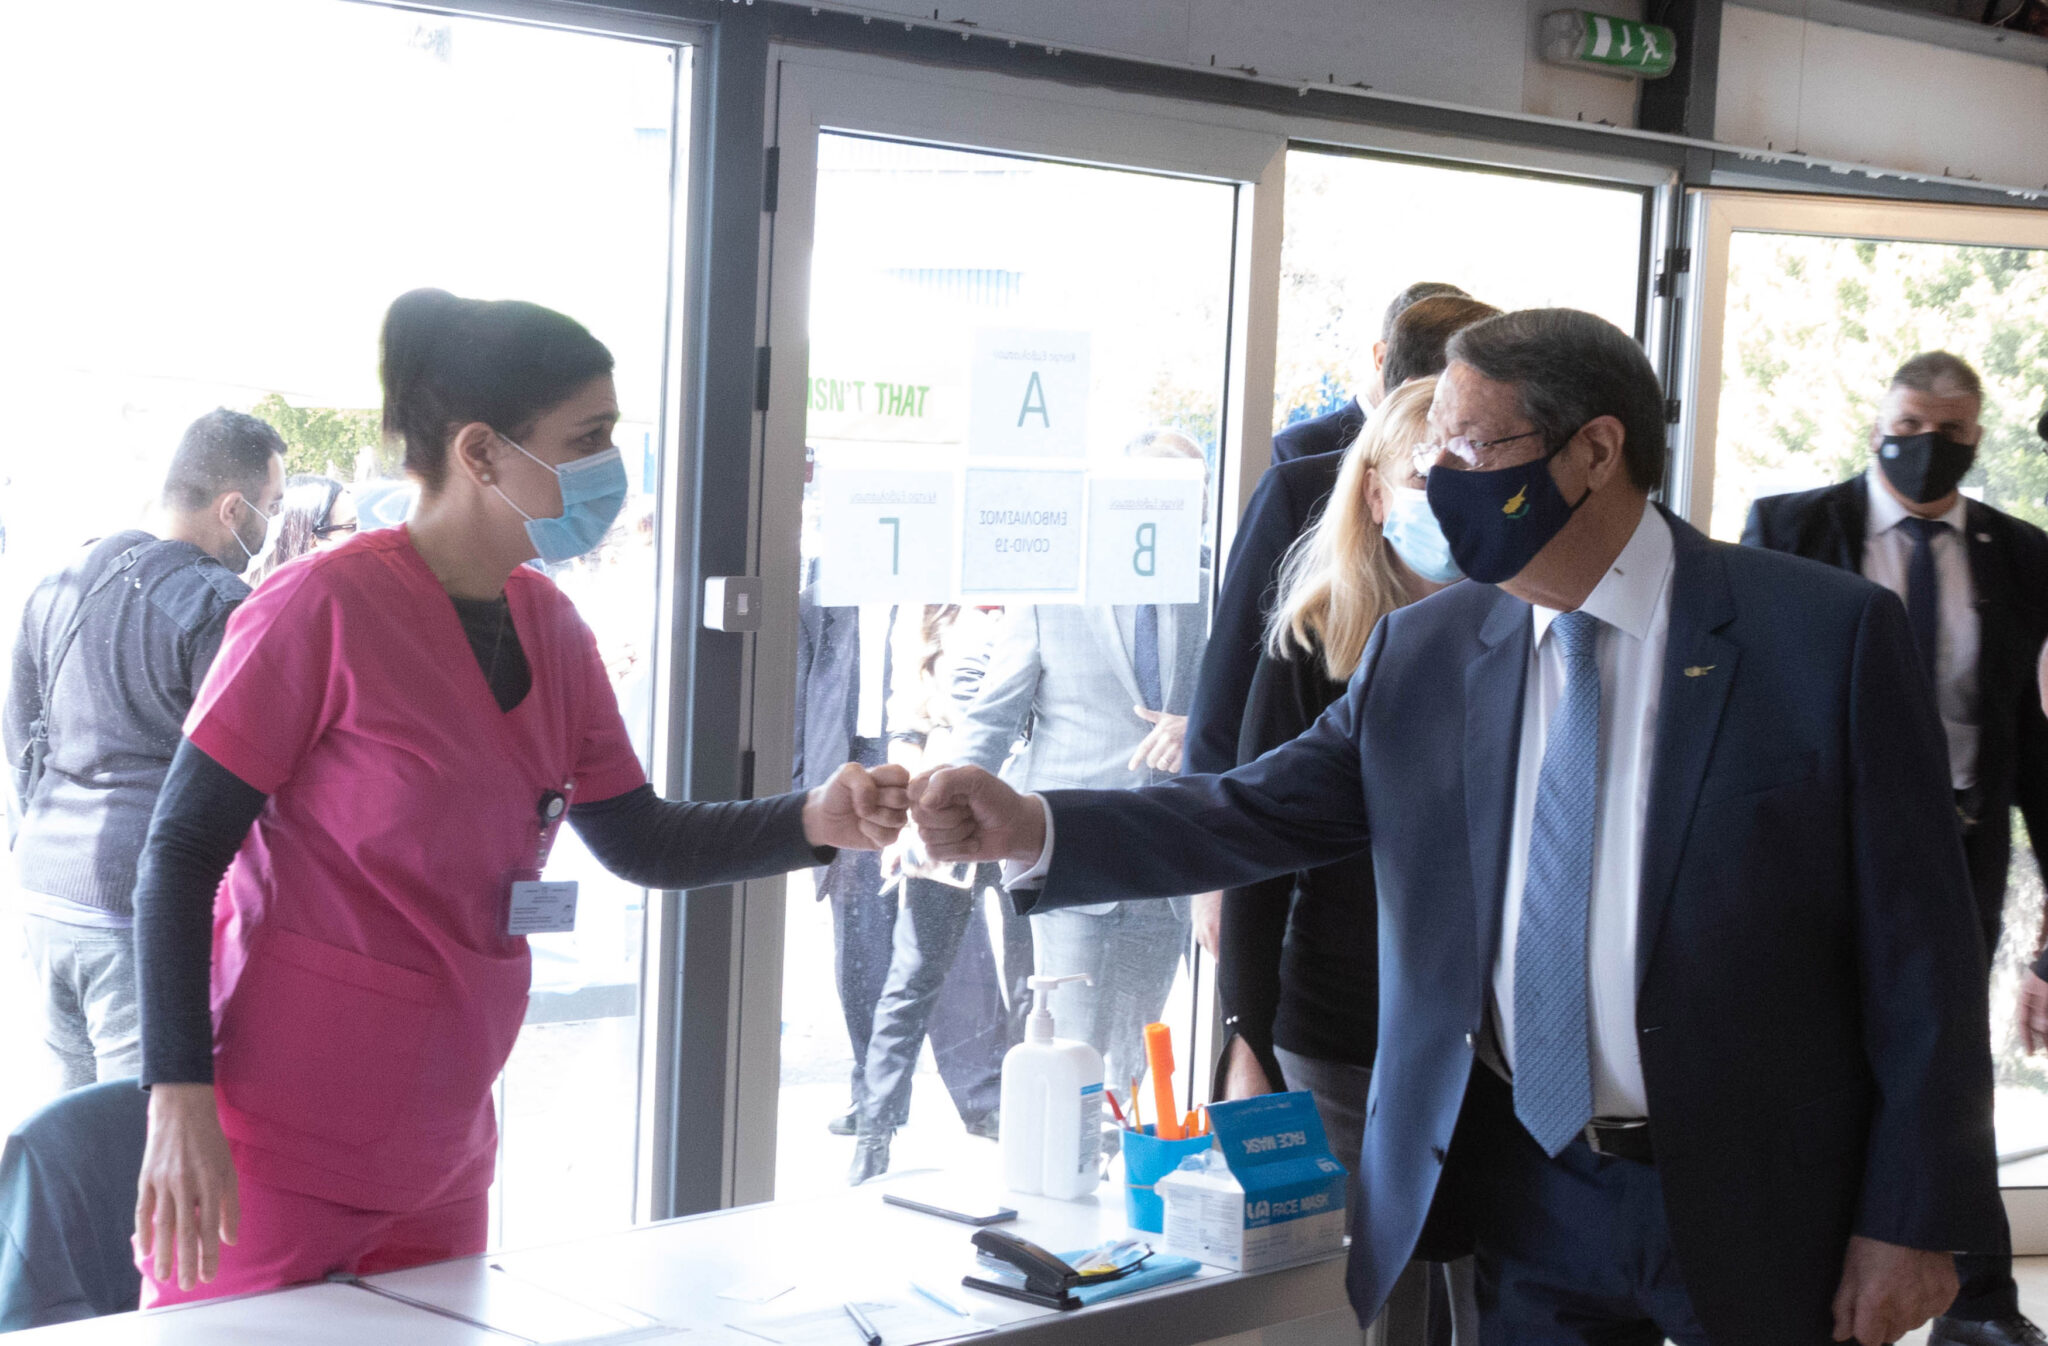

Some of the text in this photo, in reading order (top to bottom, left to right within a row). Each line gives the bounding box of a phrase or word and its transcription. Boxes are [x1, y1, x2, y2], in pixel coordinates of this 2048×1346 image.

[807, 377, 931, 417] ISN'T THAT
[1241, 1130, 1307, 1155] FACE MASK
[1271, 1198, 1299, 1217] FACE
[1300, 1193, 1331, 1212] MASK
